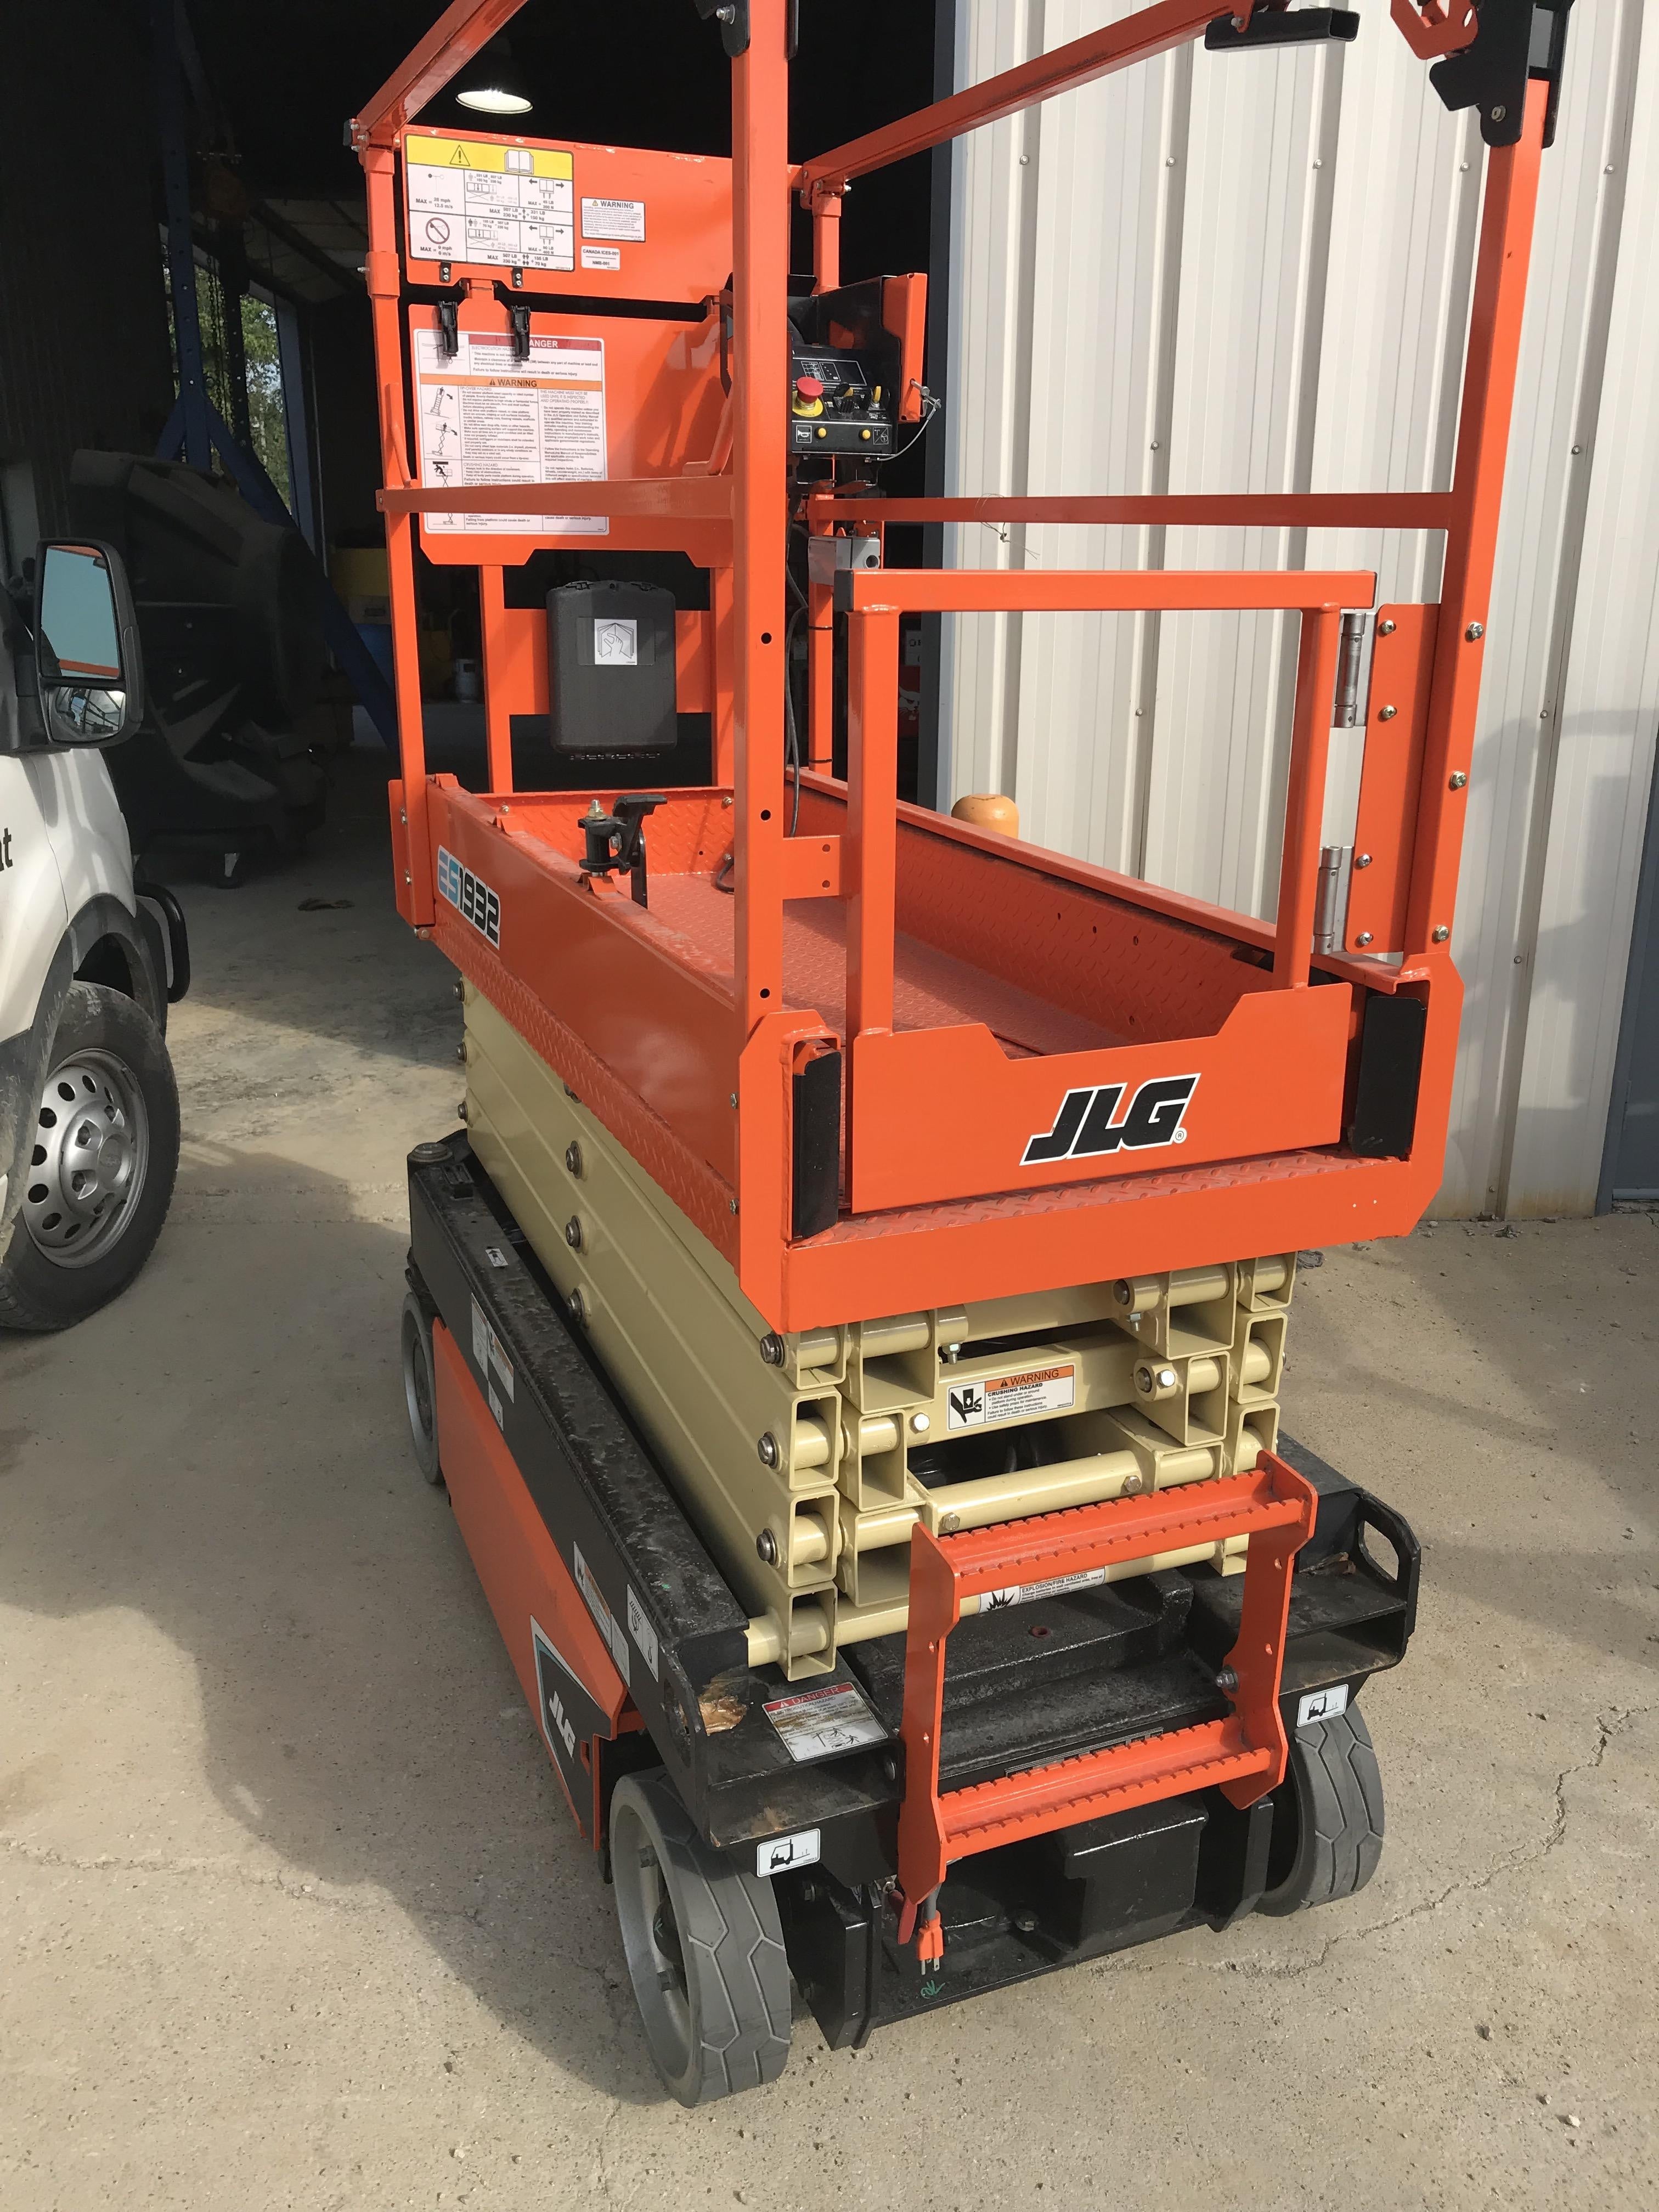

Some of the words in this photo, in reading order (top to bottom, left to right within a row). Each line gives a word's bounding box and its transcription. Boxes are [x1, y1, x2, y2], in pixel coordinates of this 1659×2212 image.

[529, 339, 558, 348] ANGER
[498, 379, 537, 387] WARNING
[439, 849, 499, 945] ES1932
[1020, 1074, 1199, 1165] JLG
[1011, 1370, 1059, 1385] WARNING
[988, 1387, 1018, 1397] CRUSHING
[1022, 1579, 1065, 1593] EXPLOSION/FIRE
[1066, 1573, 1087, 1583] HAZARD
[791, 1688, 840, 1704] DANGER
[549, 1690, 575, 1758] JLG
